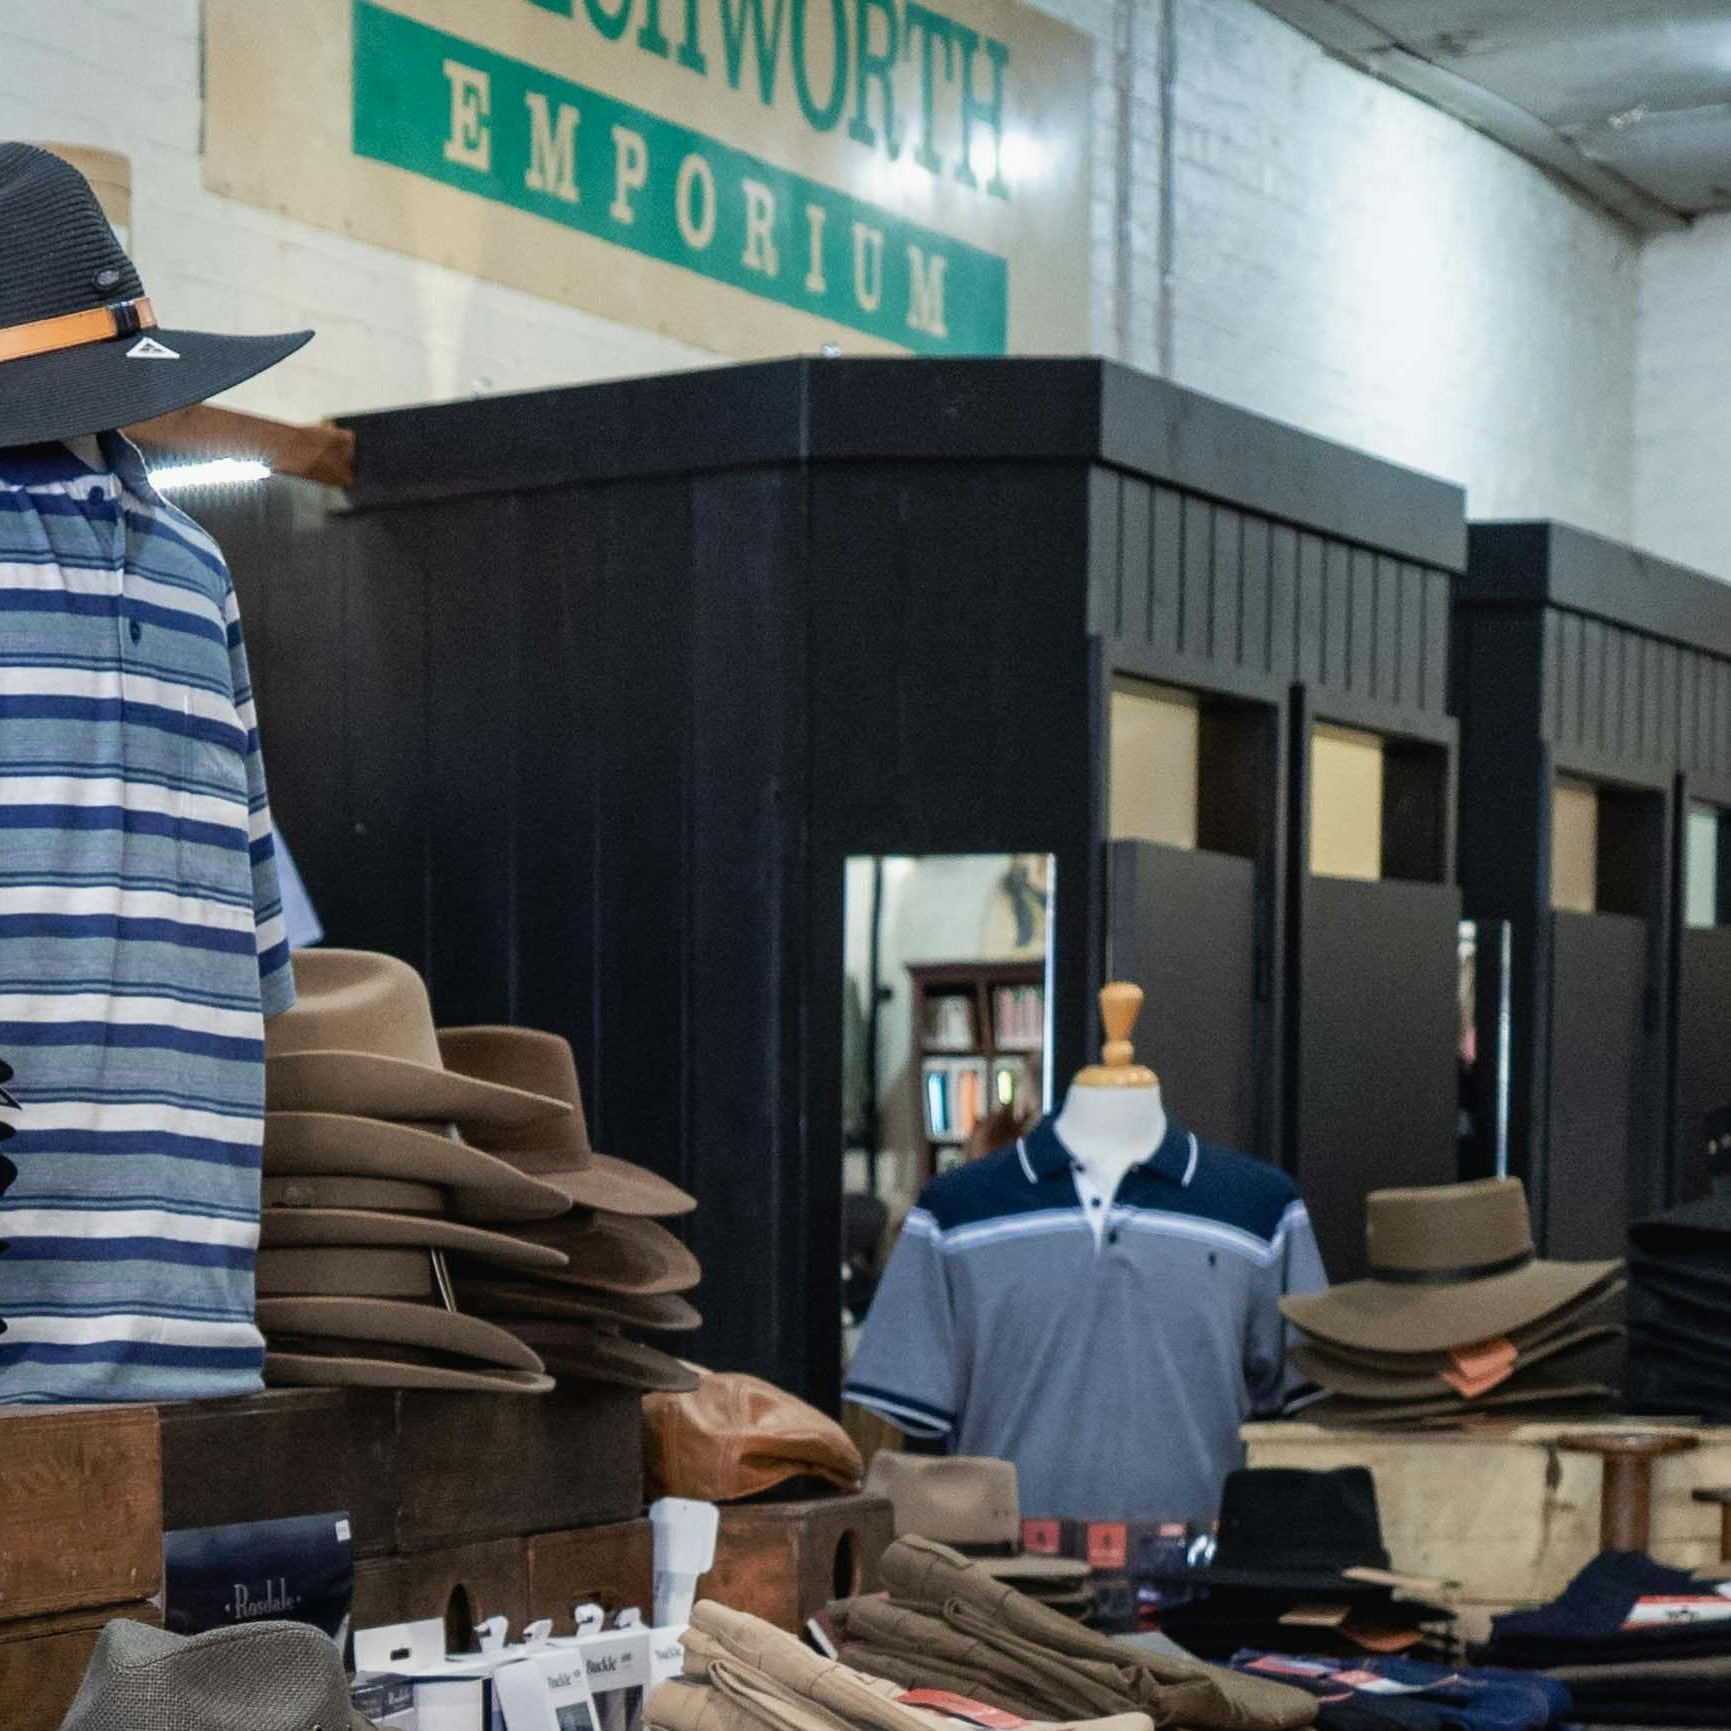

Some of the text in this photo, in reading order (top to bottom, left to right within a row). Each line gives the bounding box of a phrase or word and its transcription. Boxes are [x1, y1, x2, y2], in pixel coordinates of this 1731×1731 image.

[527, 0, 1010, 200] WORTH
[442, 58, 949, 338] EMPORIUM
[233, 1577, 295, 1620] Rosdale
[586, 1655, 617, 1675] Buckle
